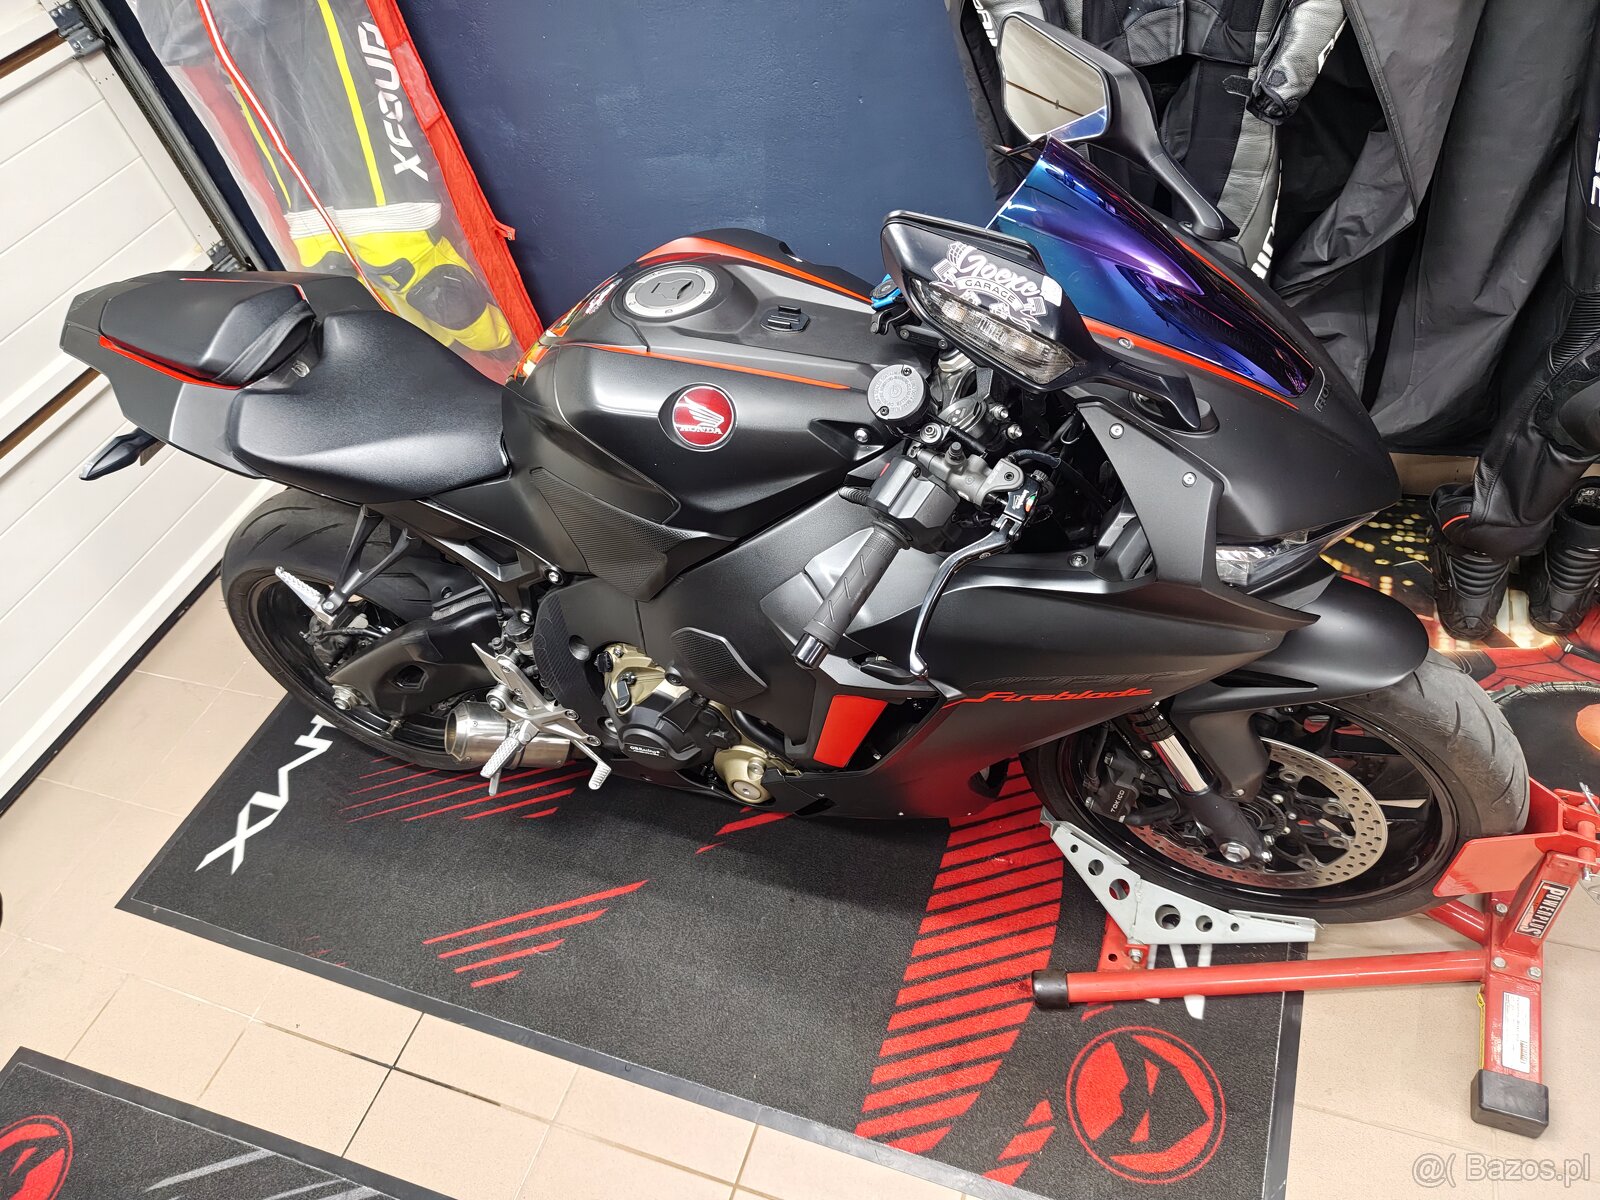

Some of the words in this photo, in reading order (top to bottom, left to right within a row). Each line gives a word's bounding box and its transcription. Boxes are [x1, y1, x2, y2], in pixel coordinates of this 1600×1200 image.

[964, 279, 1016, 304] GARAGE
[966, 687, 1153, 703] Fireblade
[1110, 789, 1125, 813] TOKICO
[1519, 884, 1567, 937] POWERPLUS
